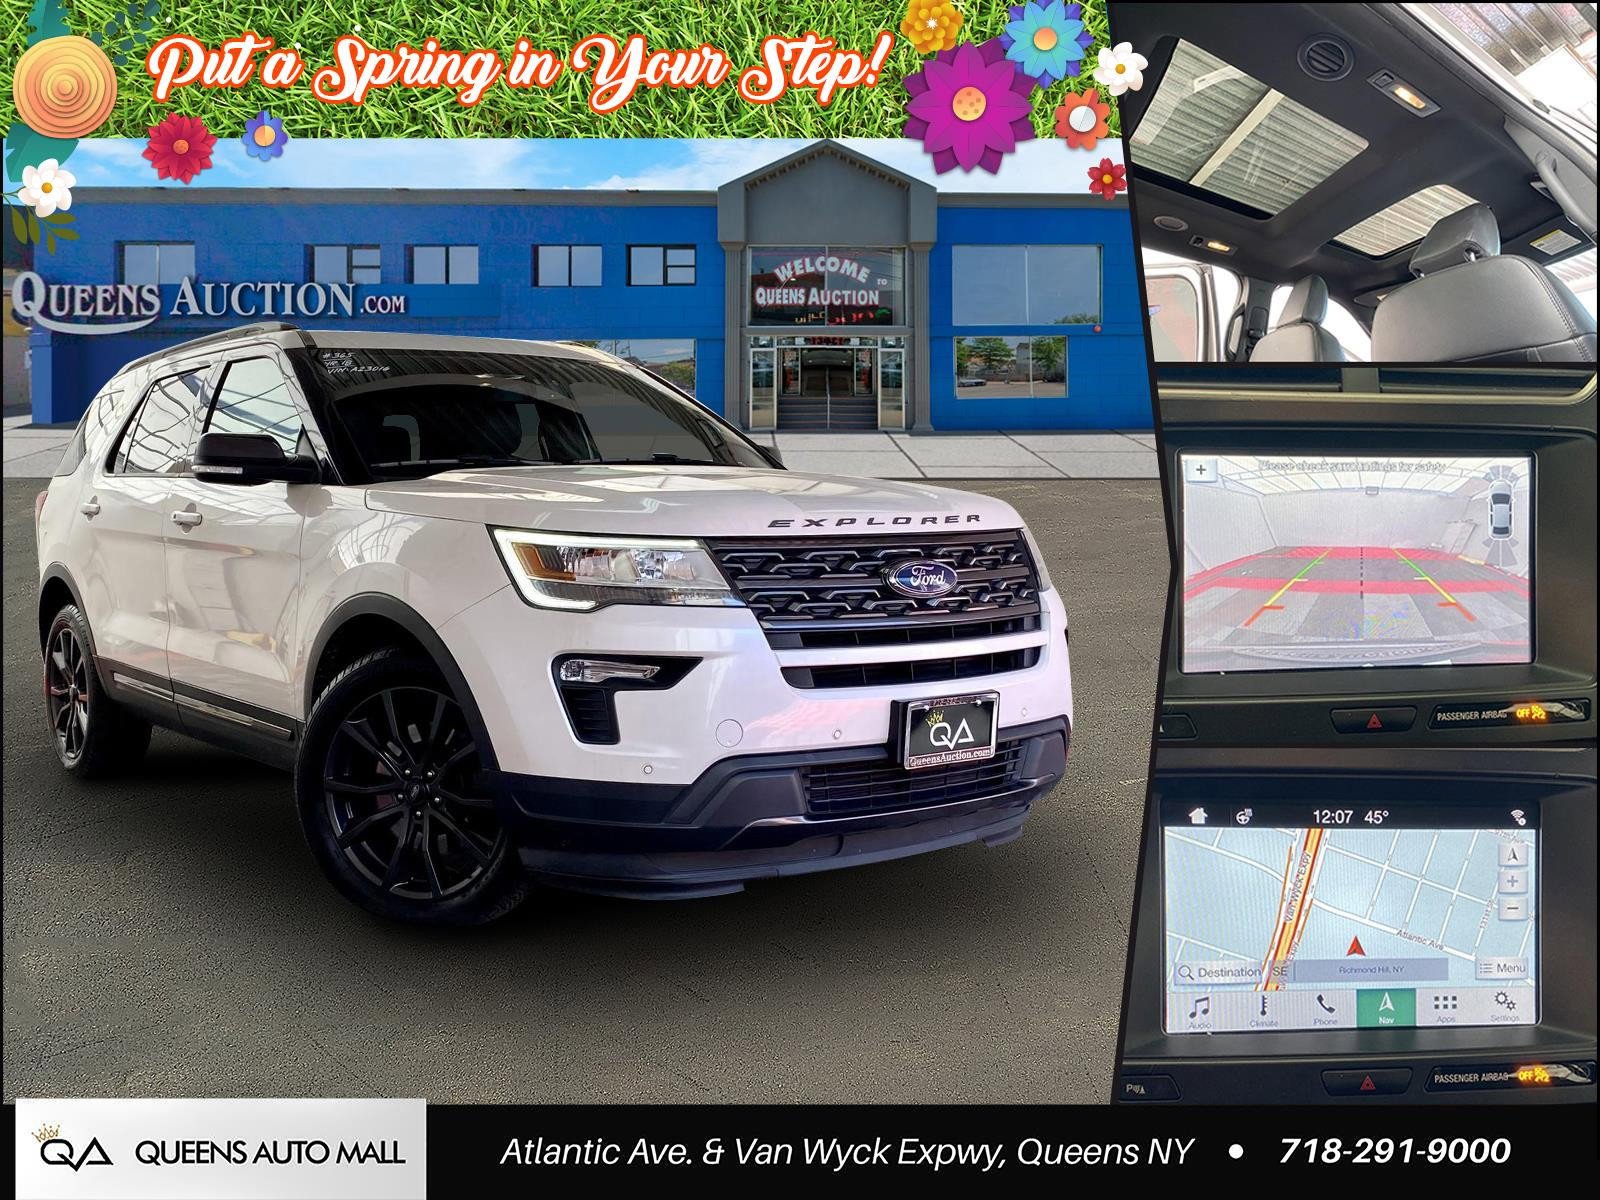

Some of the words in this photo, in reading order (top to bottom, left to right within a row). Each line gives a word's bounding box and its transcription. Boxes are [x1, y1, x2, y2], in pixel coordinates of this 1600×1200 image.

[774, 256, 871, 284] WELCOME
[11, 271, 161, 335] QUEENS
[756, 287, 806, 306] QUEENS
[808, 287, 879, 306] AUCTION
[768, 514, 981, 528] EXPLORER
[910, 565, 946, 587] Ford
[1437, 712, 1480, 721] PASSENGER
[1481, 710, 1507, 720] AIRBAG
[1516, 708, 1530, 718] OFF
[930, 718, 974, 750] QA
[910, 748, 991, 766] QueensAuction.com
[1313, 809, 1353, 824] 12:07
[1364, 809, 1389, 824] 45°
[1285, 902, 1297, 922] Van
[1291, 877, 1304, 903] Wyck
[1298, 852, 1312, 876] Expy
[1396, 929, 1427, 946] Atlantic
[1427, 939, 1445, 952] Ave
[1198, 966, 1262, 979] Destination
[1272, 966, 1288, 977] SE
[1339, 966, 1376, 974] Richmond
[1392, 965, 1405, 973] NY
[1497, 962, 1527, 974] Menu
[1189, 1021, 1212, 1030] Audio
[1250, 1019, 1278, 1028] Climate
[1313, 1018, 1339, 1026] Phone
[1378, 1016, 1394, 1024] Nav
[1437, 1015, 1456, 1024] Apps
[1490, 1014, 1520, 1023] Settings
[1434, 1073, 1479, 1084] PASSENGER
[1481, 1072, 1509, 1082] AIRBAG
[1518, 1071, 1534, 1081] OFF
